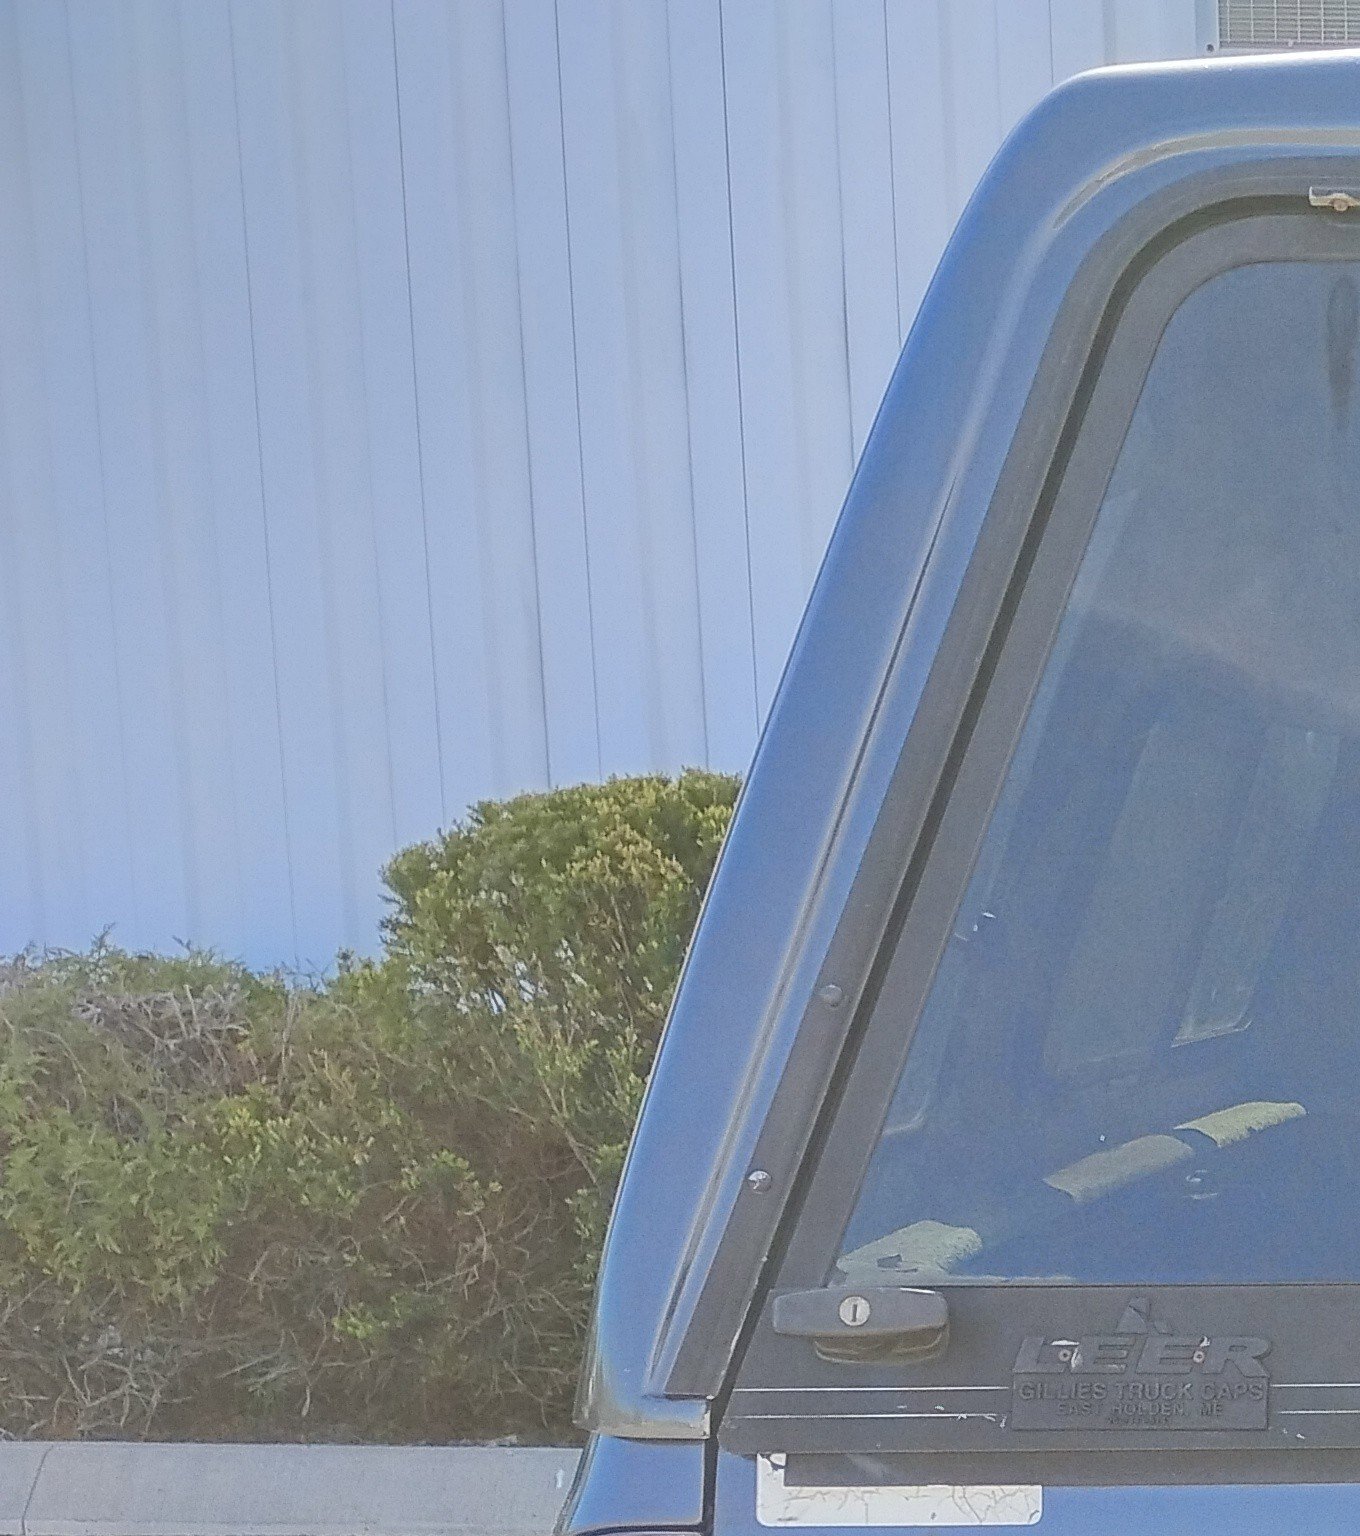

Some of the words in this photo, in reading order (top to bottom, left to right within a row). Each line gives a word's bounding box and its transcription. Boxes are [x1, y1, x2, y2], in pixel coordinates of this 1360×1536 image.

[1012, 1335, 1272, 1377] LEER
[1018, 1381, 1108, 1401] GILLIES
[1115, 1381, 1194, 1400] TRUCK
[1200, 1381, 1264, 1401] CAPS
